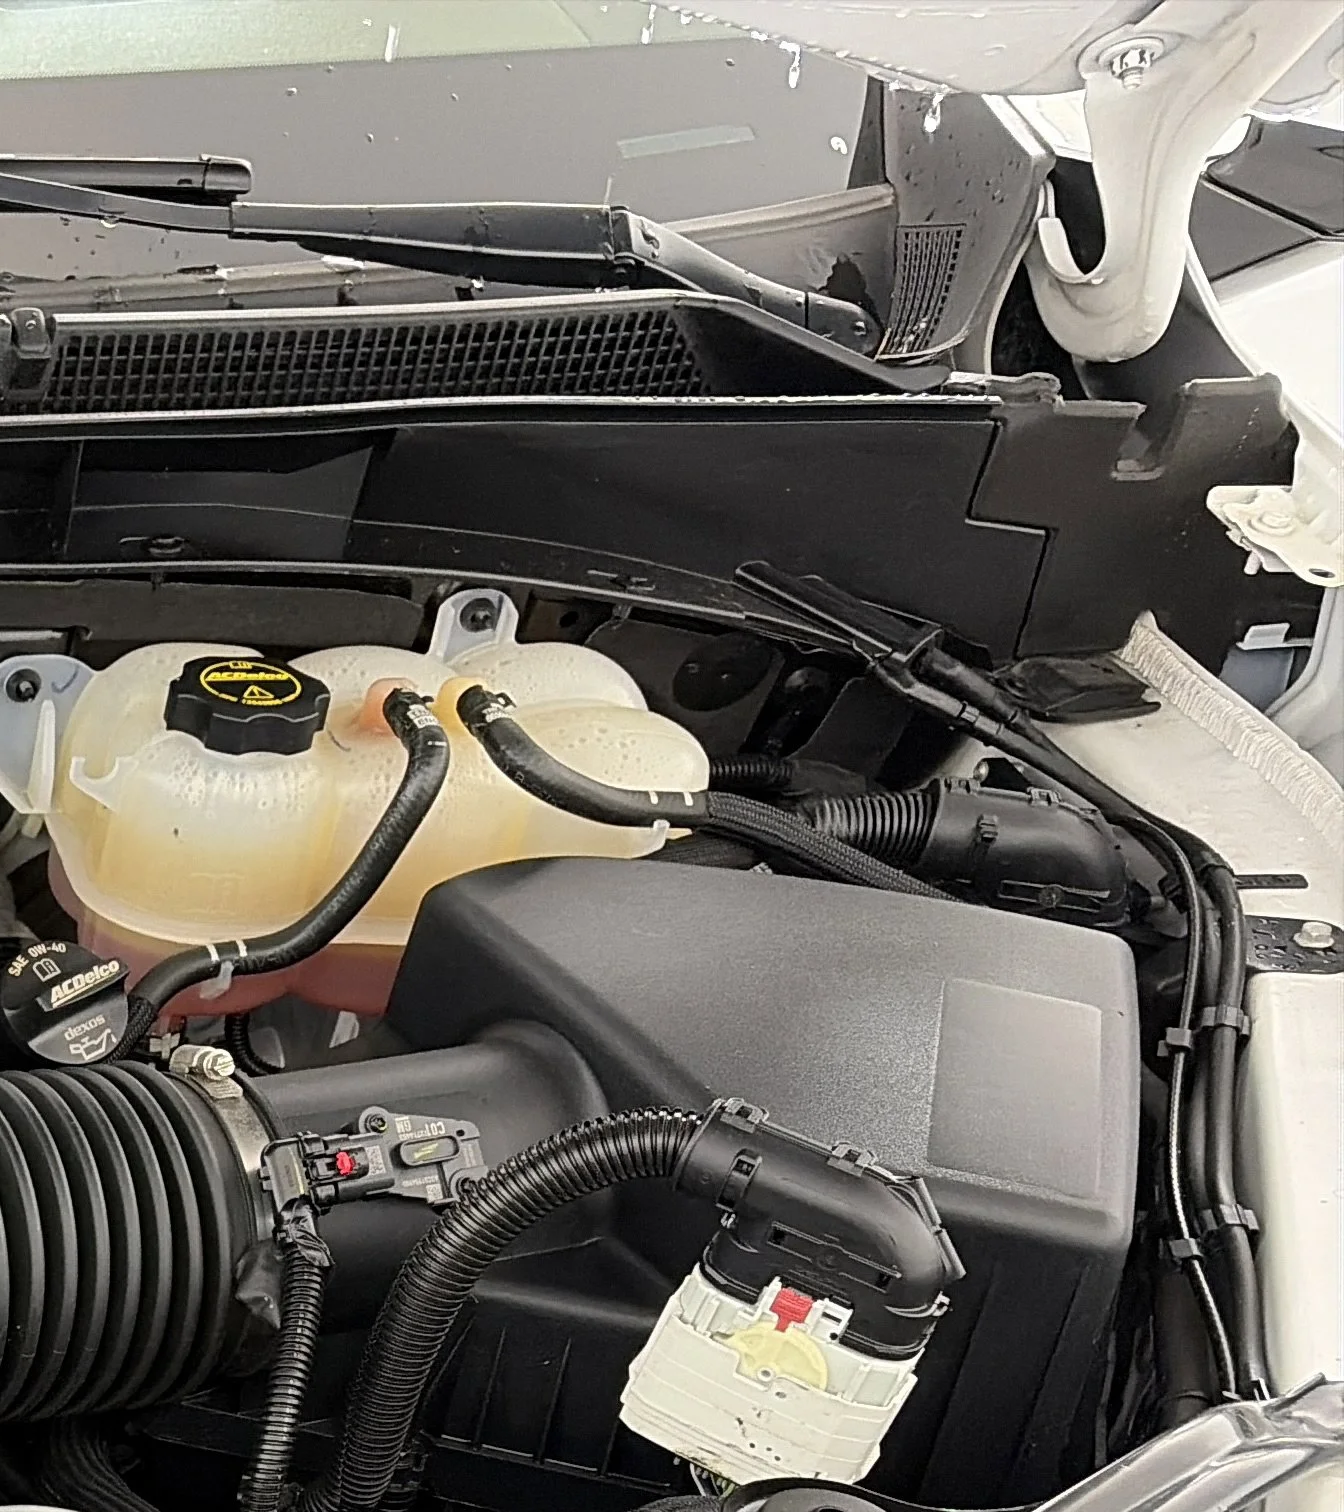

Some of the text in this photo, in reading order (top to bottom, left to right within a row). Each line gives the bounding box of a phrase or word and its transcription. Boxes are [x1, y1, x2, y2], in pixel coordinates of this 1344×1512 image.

[8, 954, 29, 977] SAE
[51, 960, 120, 1003] ACDelco
[64, 1014, 106, 1041] dexos
